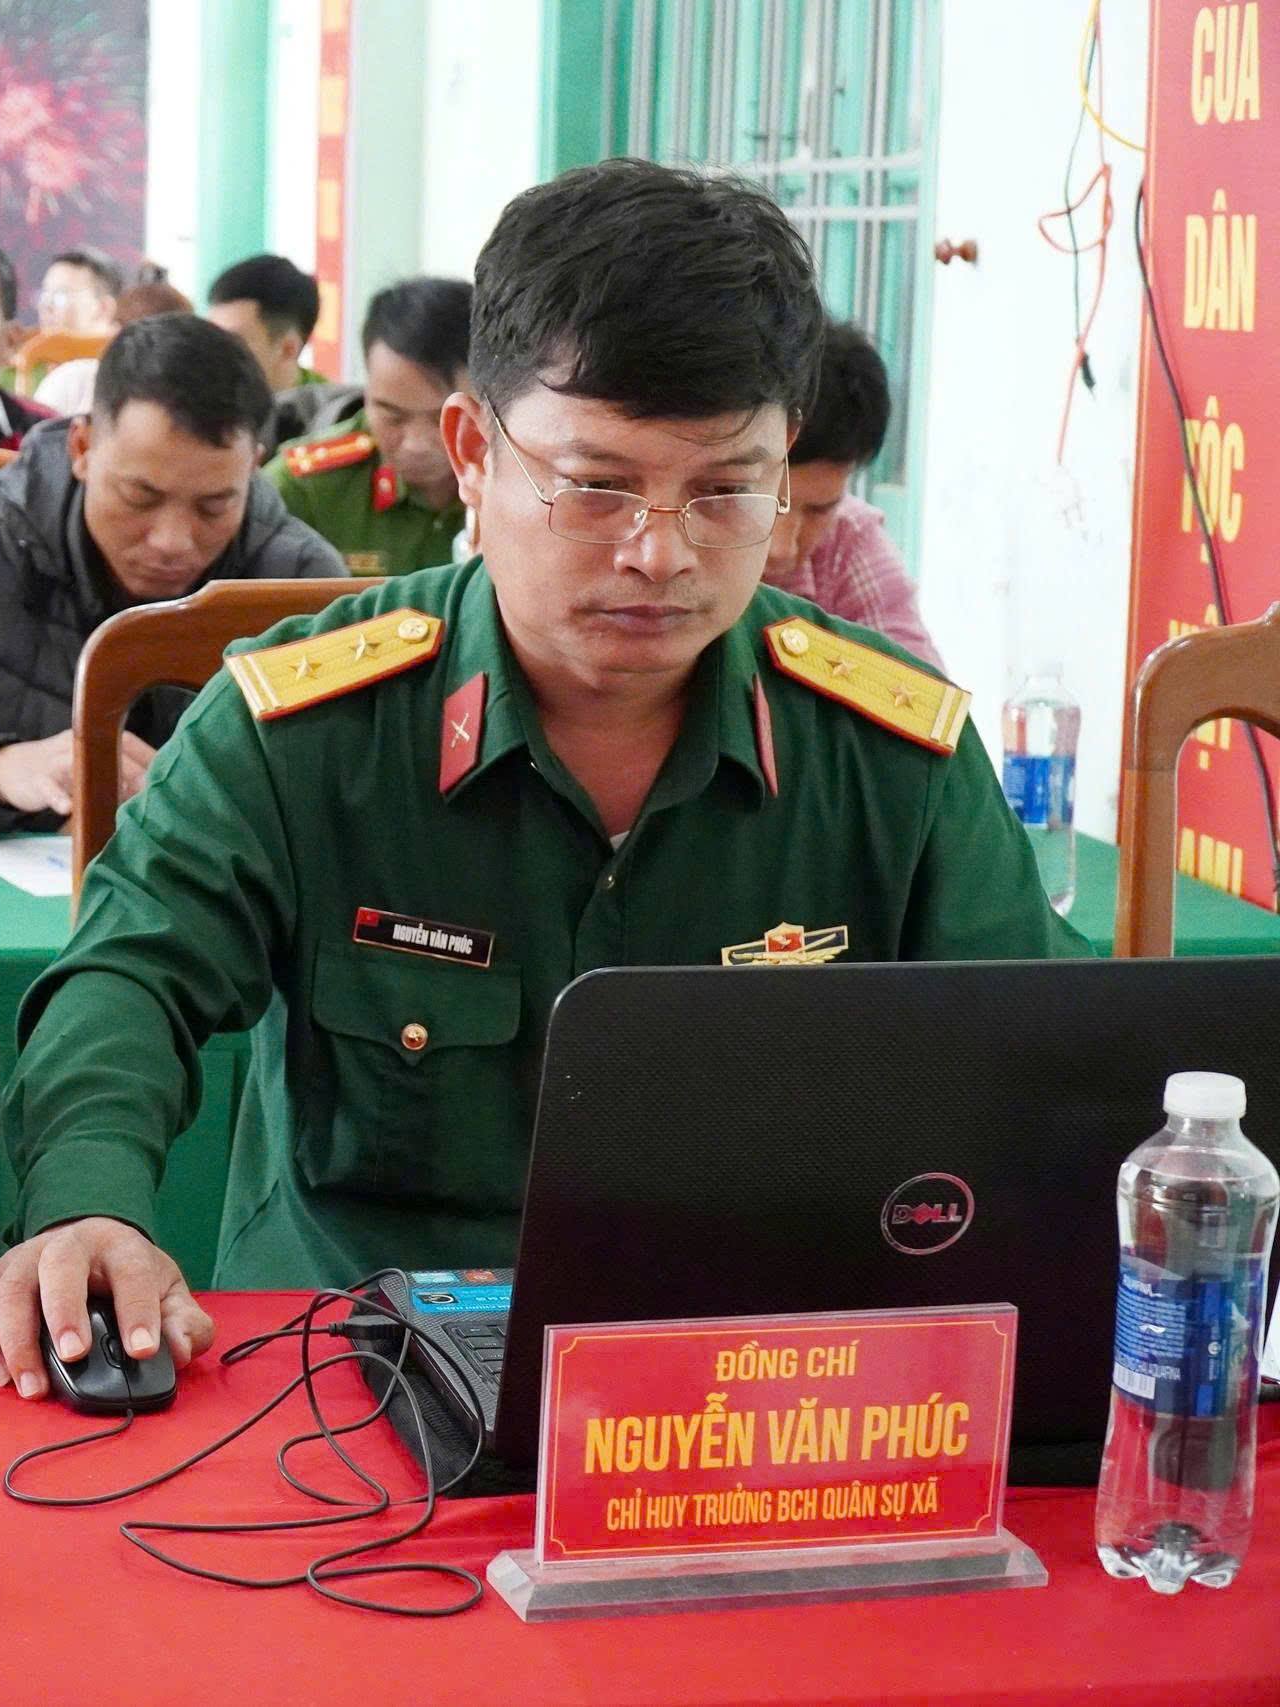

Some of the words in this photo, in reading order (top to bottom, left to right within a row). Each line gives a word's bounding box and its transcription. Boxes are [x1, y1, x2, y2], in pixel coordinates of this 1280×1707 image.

[1183, 188, 1257, 332] DÂN
[429, 929, 449, 950] VĂN
[448, 934, 474, 955] PHÚC
[715, 1340, 798, 1382] ĐỒNG
[806, 1339, 860, 1378] CHÍ
[584, 1392, 757, 1474] NGUYỄN
[767, 1397, 851, 1465] VĂN
[860, 1392, 970, 1459] PHÚC
[606, 1487, 643, 1531] CHỈ
[644, 1495, 689, 1529] HUY
[692, 1482, 774, 1527] TRƯỞNG
[776, 1488, 818, 1522] BCH
[822, 1480, 875, 1520] QUÂN
[879, 1480, 909, 1523] SỰ
[910, 1476, 939, 1514] XÃ
